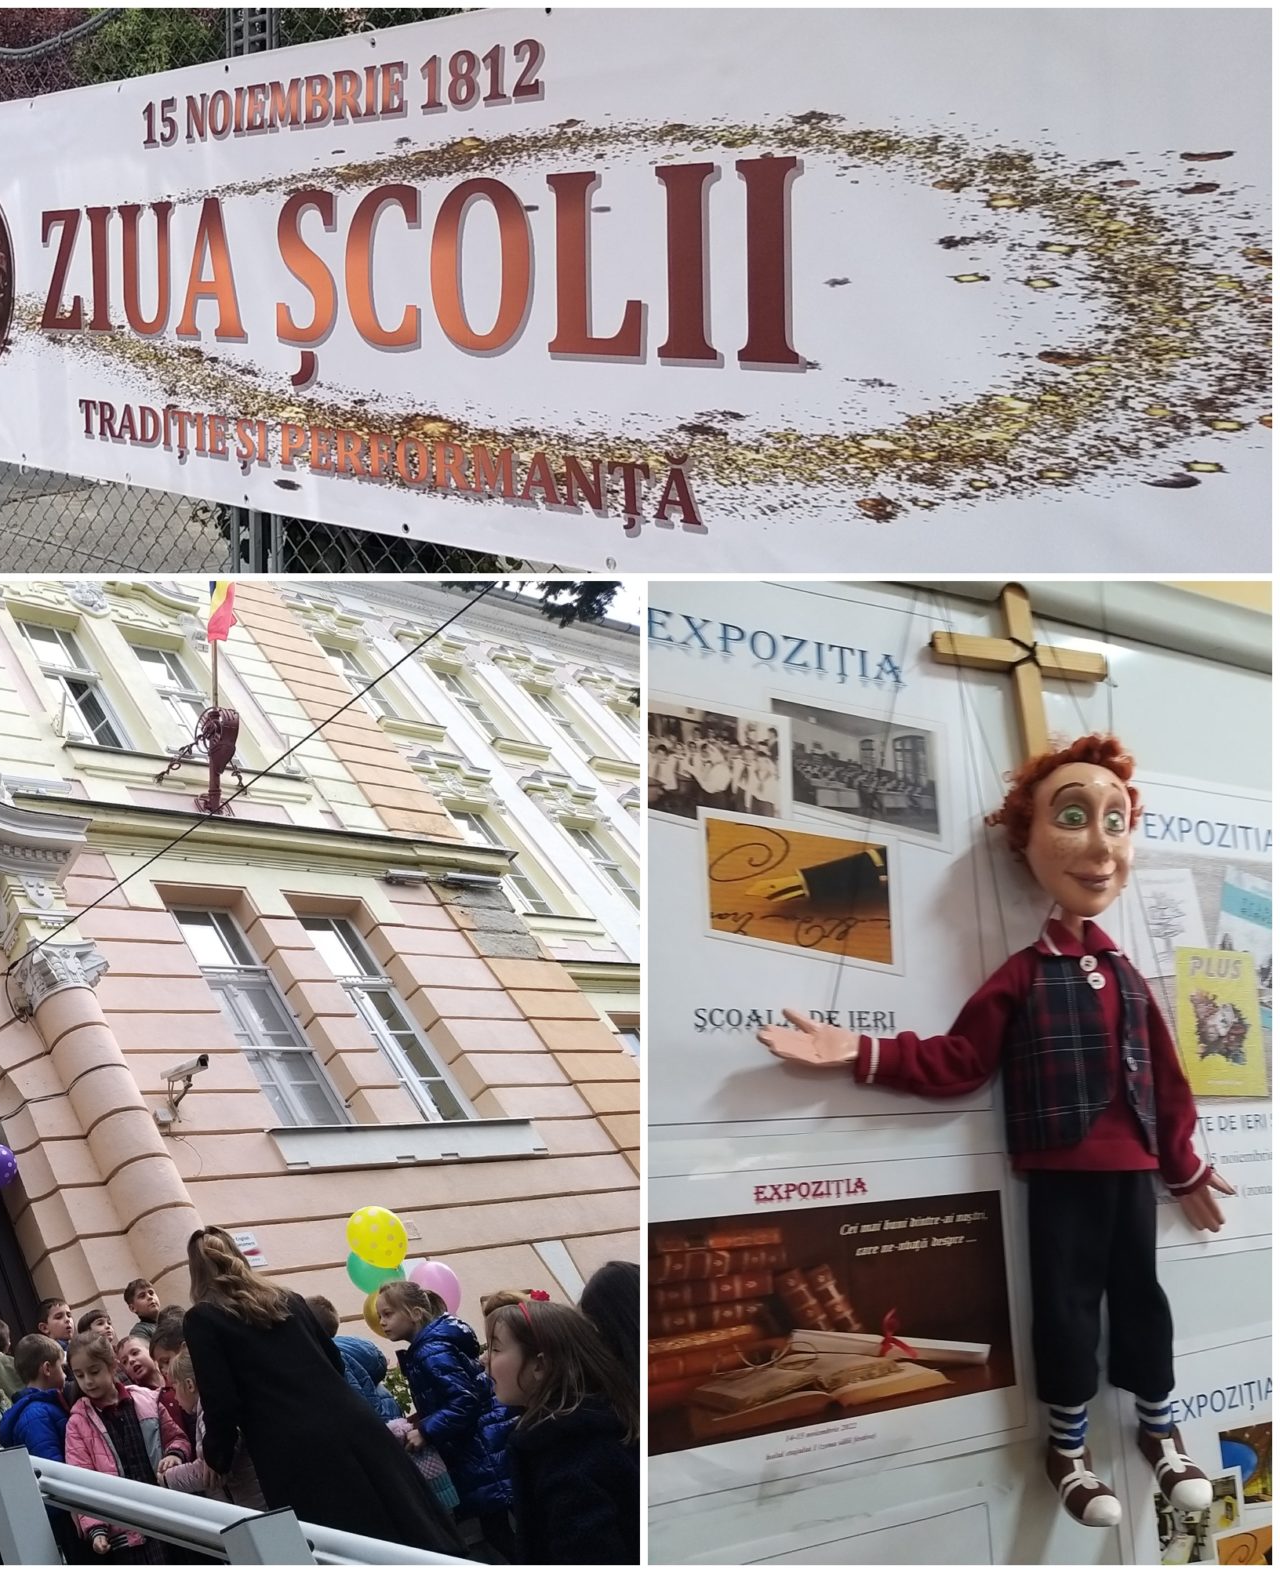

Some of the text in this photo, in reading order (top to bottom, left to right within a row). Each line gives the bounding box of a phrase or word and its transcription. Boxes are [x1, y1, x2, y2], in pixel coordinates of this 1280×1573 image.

[142, 38, 545, 148] 15 NOIEMBRIE 1812
[41, 156, 805, 387] ZIUA ȘCOLII
[78, 399, 709, 538] TRADIȚIE ȘI PERFORMANȚĂ
[648, 607, 905, 684] EXPOZIȚIA
[1190, 955, 1242, 979] PLUS
[848, 1010, 896, 1029] IERI
[1218, 1115, 1237, 1131] DE
